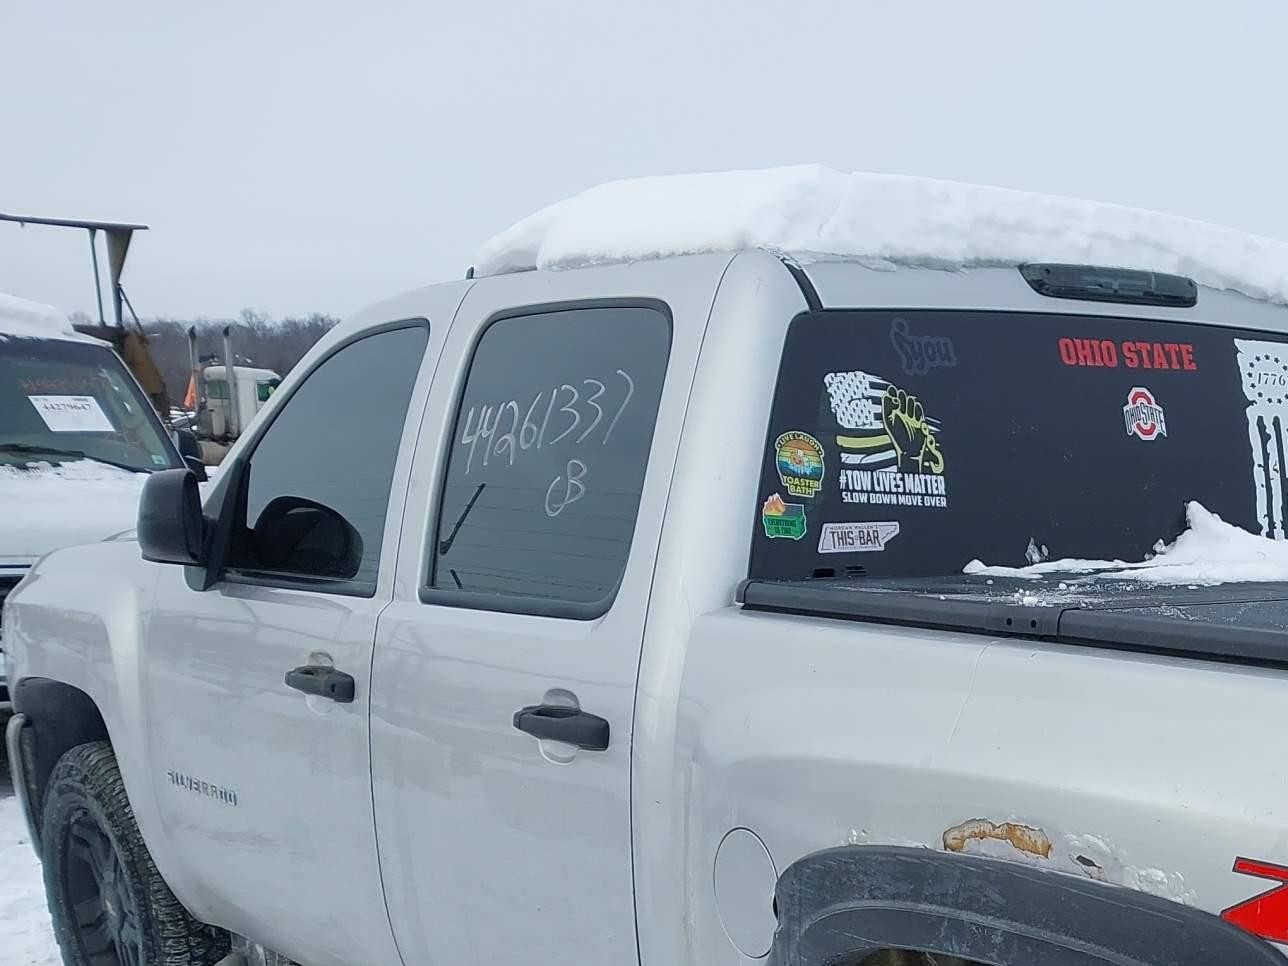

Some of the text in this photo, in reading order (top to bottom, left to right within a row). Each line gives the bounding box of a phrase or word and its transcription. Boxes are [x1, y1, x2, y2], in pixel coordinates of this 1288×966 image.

[1058, 338, 1198, 371] OHIO STATE
[1257, 372, 1287, 386] 1776
[779, 433, 820, 450] LIVE LAUGH
[782, 475, 819, 488] TOASTER
[839, 469, 946, 495] #TOW LIVES MATTER
[790, 485, 812, 495] BATH
[841, 492, 947, 507] SLOW DOWN MOVE OVER
[829, 530, 882, 549] THIS BAR
